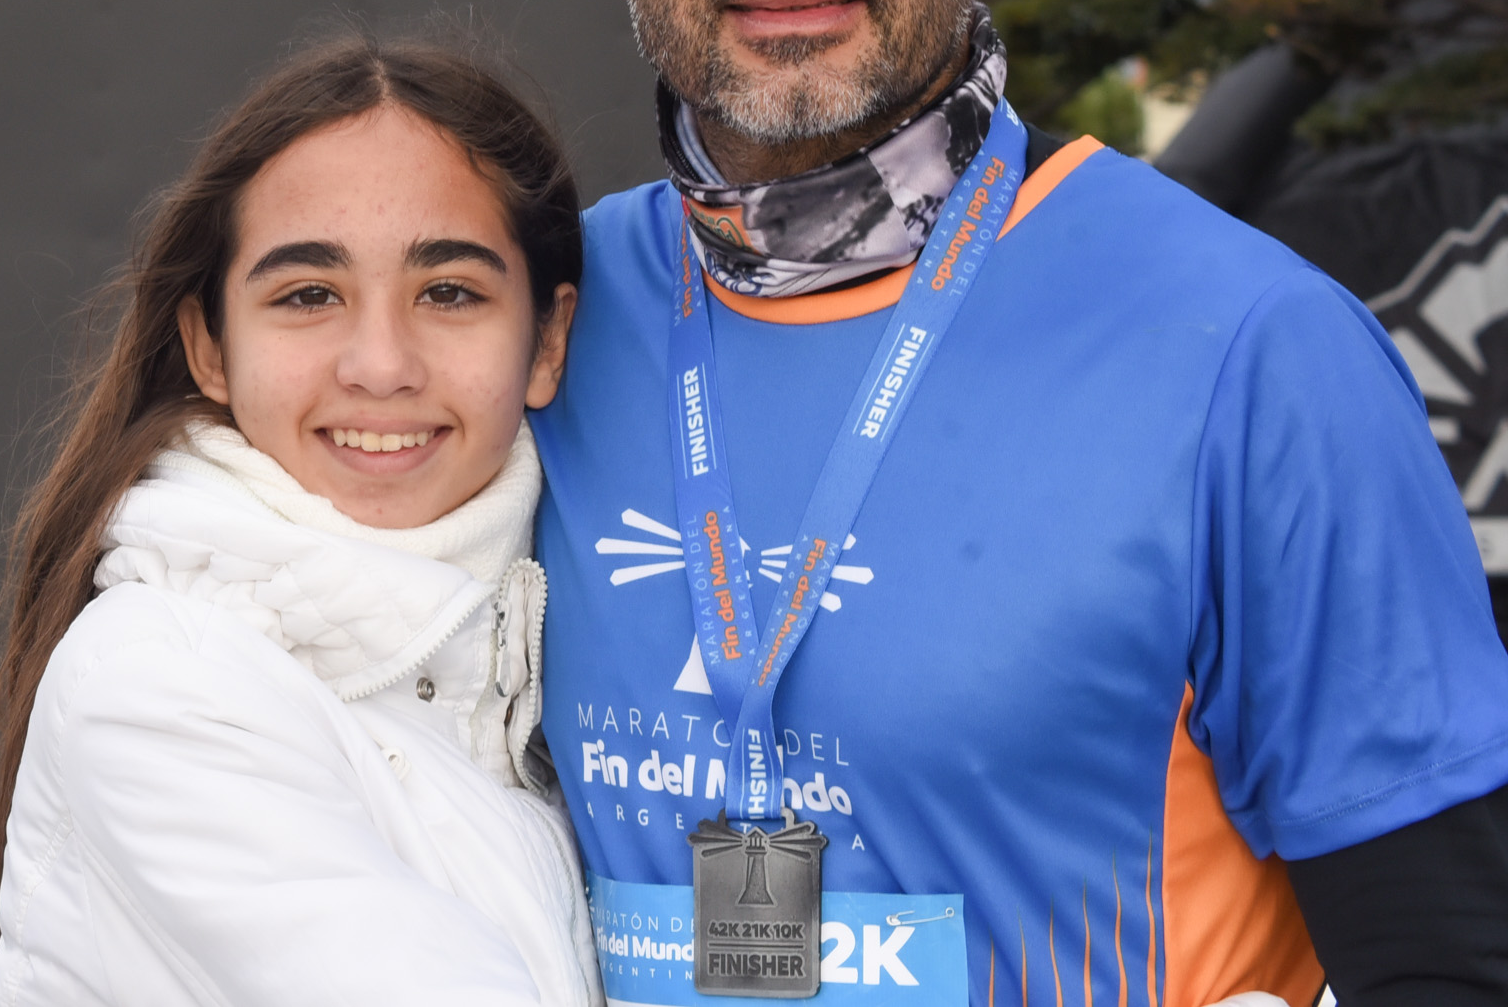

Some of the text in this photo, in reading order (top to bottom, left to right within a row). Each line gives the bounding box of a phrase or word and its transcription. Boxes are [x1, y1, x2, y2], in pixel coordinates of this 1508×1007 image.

[917, 148, 985, 285] ARGENTINA
[930, 156, 1006, 291] Fin del Mundo
[949, 167, 1020, 297] MARATÓN DEL
[683, 365, 709, 476] FINISHER
[860, 326, 927, 438] FINISHER
[687, 514, 721, 665] MARATÓN DEL
[703, 511, 742, 660] Fin del Mundo
[723, 505, 756, 656] ARGENTINA
[757, 538, 826, 687] Fin del Mundo
[582, 739, 628, 789] Fin
[638, 749, 696, 797] del
[748, 728, 768, 820] FINISH
[783, 729, 849, 767] DEL
[608, 932, 629, 957] del
[632, 935, 695, 962] Mund
[708, 921, 805, 940] 42K 21K 10K
[708, 953, 805, 977] FINISHER
